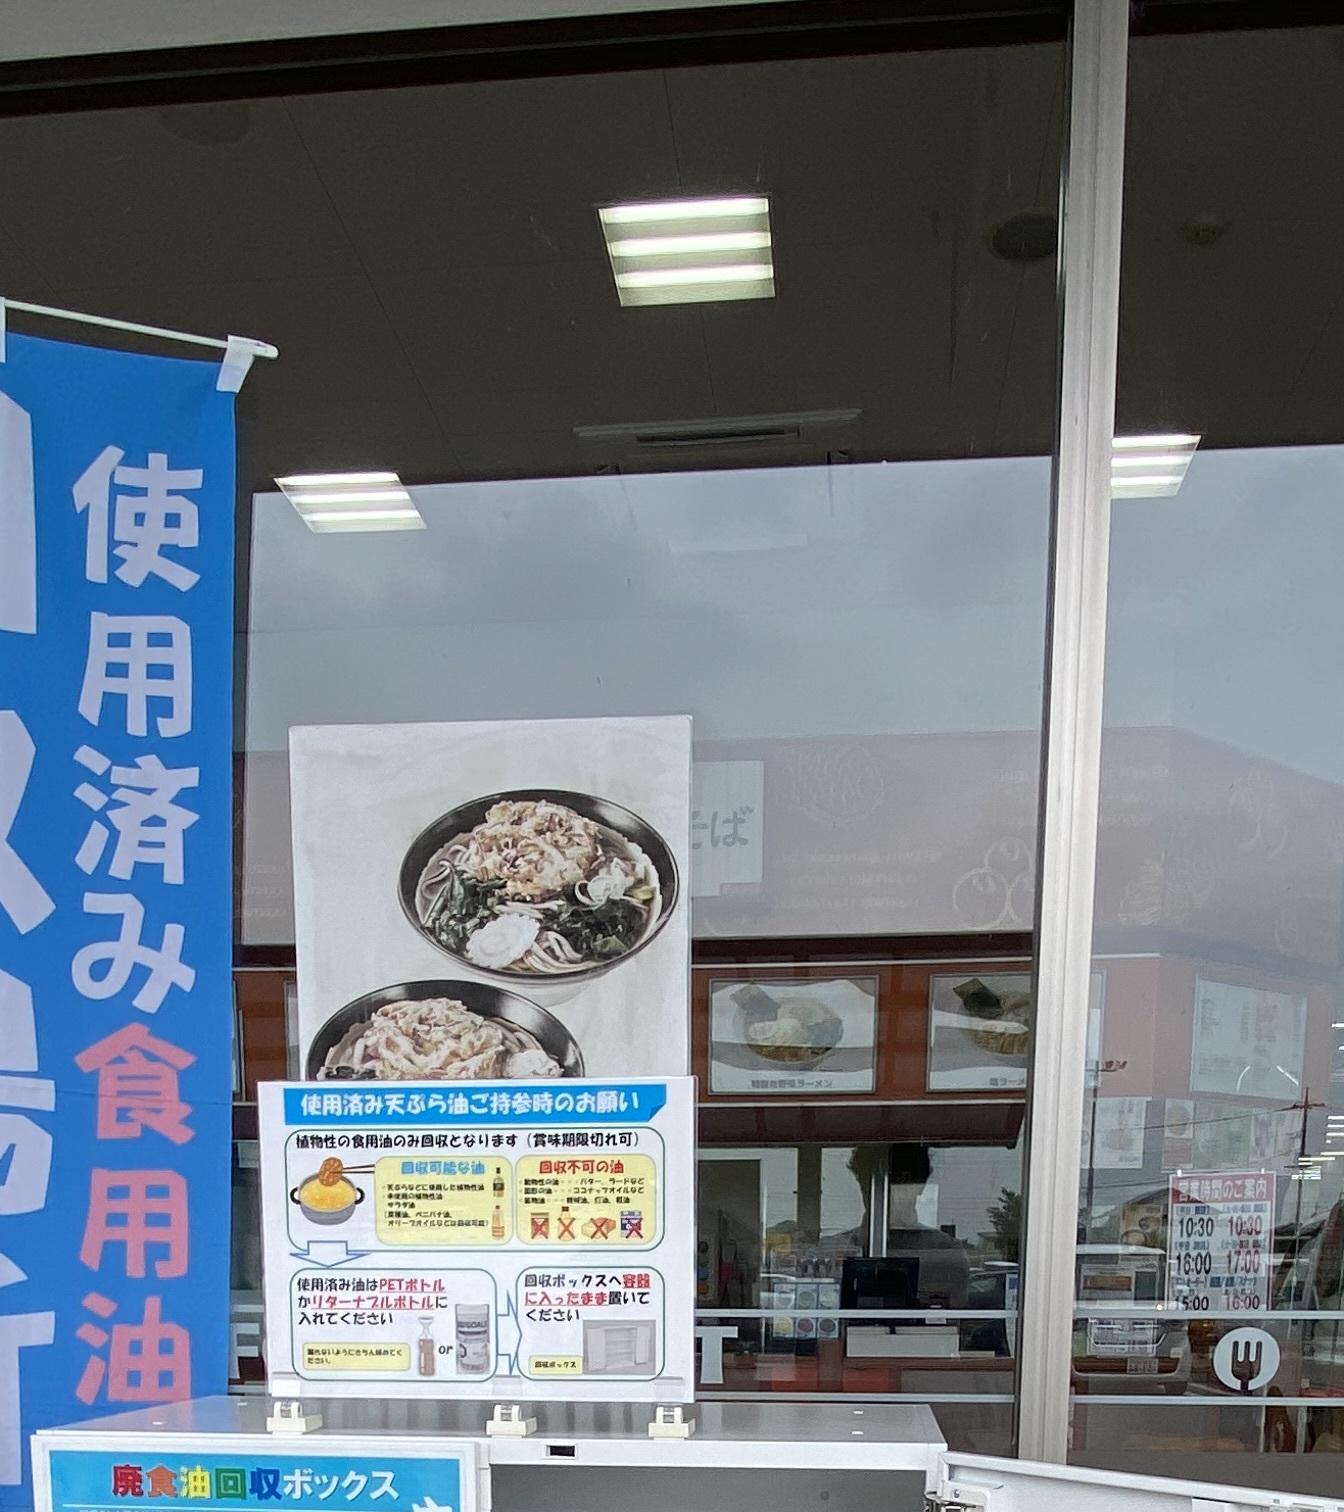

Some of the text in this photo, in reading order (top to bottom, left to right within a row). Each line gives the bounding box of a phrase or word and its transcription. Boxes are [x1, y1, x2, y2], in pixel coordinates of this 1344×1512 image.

[71, 445, 205, 1403] 使用済み食用油
[300, 1088, 640, 1118] 使用済み天ぷら油ご持参時のお願い
[295, 1131, 643, 1150] 植物性の食用油のみ回収となります（賞味期限切れ可）
[400, 1160, 486, 1176] 回収可能な油
[538, 1159, 625, 1175] 回収不可の油
[1178, 1215, 1262, 1238] 10:30 10:30
[1176, 1252, 1212, 1275] 16:00
[296, 1276, 446, 1293] 使用済み油はPETボトル
[524, 1272, 651, 1289] 回収ボックスへ容器
[297, 1293, 448, 1310] かリターナブルボトルに
[524, 1290, 650, 1308] に入ったまま置いて
[297, 1310, 393, 1326] 入れてください
[525, 1308, 580, 1323] ください
[438, 1344, 454, 1355] or
[534, 1360, 577, 1370] 回収ボックス
[112, 1463, 400, 1501] 廃食油回収ボックス
